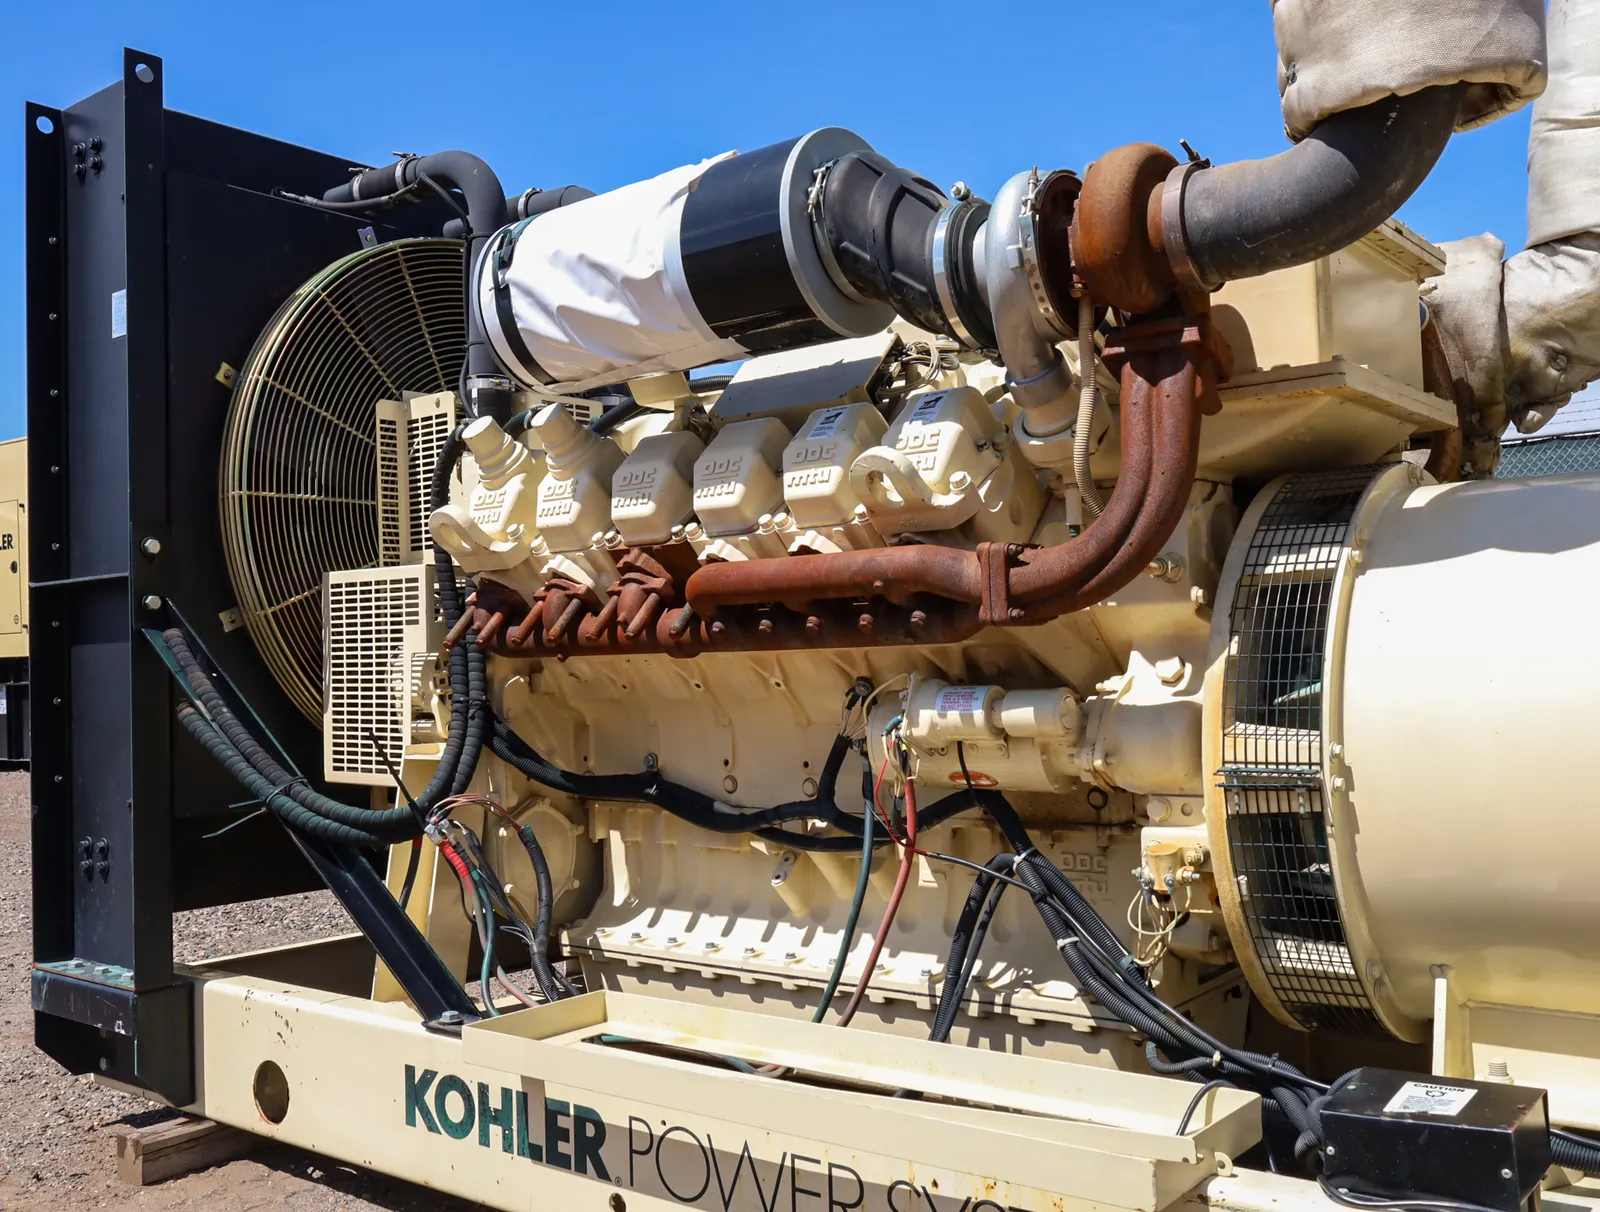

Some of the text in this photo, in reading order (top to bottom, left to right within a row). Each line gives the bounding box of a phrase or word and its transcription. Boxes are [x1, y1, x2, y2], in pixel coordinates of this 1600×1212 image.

[791, 443, 838, 465] DDC
[911, 453, 938, 472] tu
[701, 456, 743, 477] DDC
[618, 468, 658, 489] DDC
[785, 466, 834, 488] mtu
[474, 490, 507, 507] DDC
[544, 479, 579, 499] DDC
[694, 479, 737, 499] mtu
[538, 501, 573, 518] mtu
[612, 490, 653, 509] mtu
[1413, 1083, 1466, 1093] CAUTION
